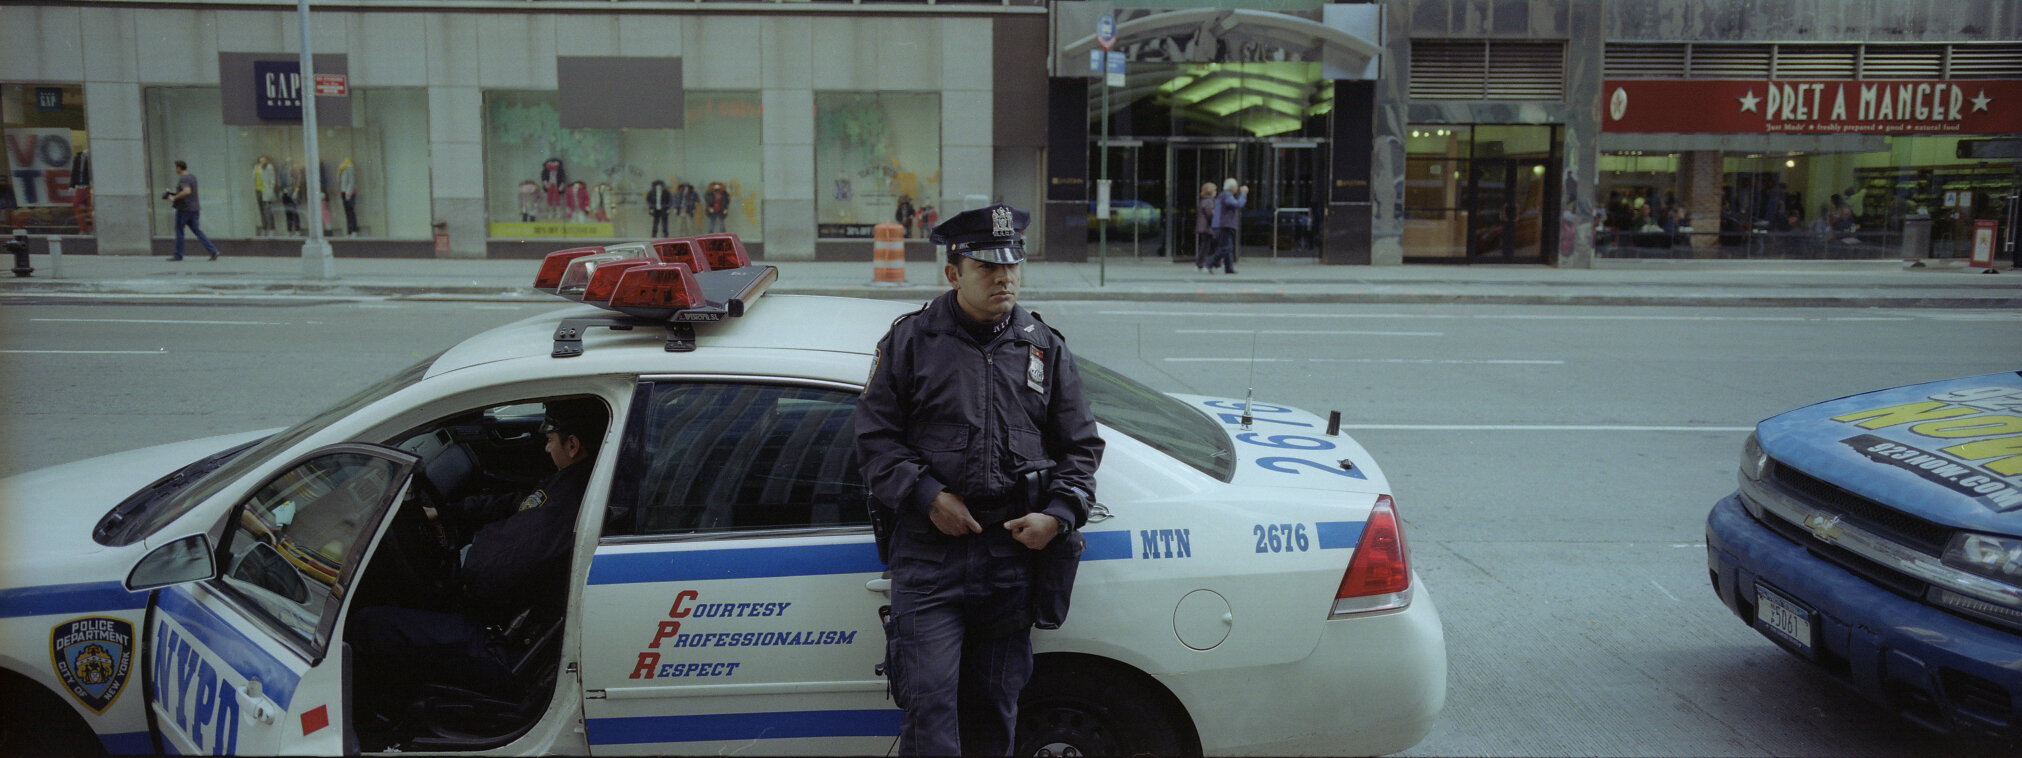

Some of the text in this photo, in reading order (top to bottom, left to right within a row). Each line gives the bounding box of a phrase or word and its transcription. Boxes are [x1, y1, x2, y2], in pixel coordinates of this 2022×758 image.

[265, 72, 300, 99] GAP
[1766, 82, 1963, 120] PRET A MANGER
[1203, 399, 1368, 480] 2676
[1140, 528, 1192, 559] MTN
[1253, 523, 1310, 554] 2676
[668, 590, 791, 619] COURTESY
[56, 630, 129, 651] DEPARTMENT
[72, 620, 115, 634] POLICE
[648, 621, 857, 649] PROFESSIONALISM
[58, 651, 130, 701] CITY OF NEW YORK
[629, 652, 741, 680] RESPECT
[152, 620, 240, 756] NYPD
